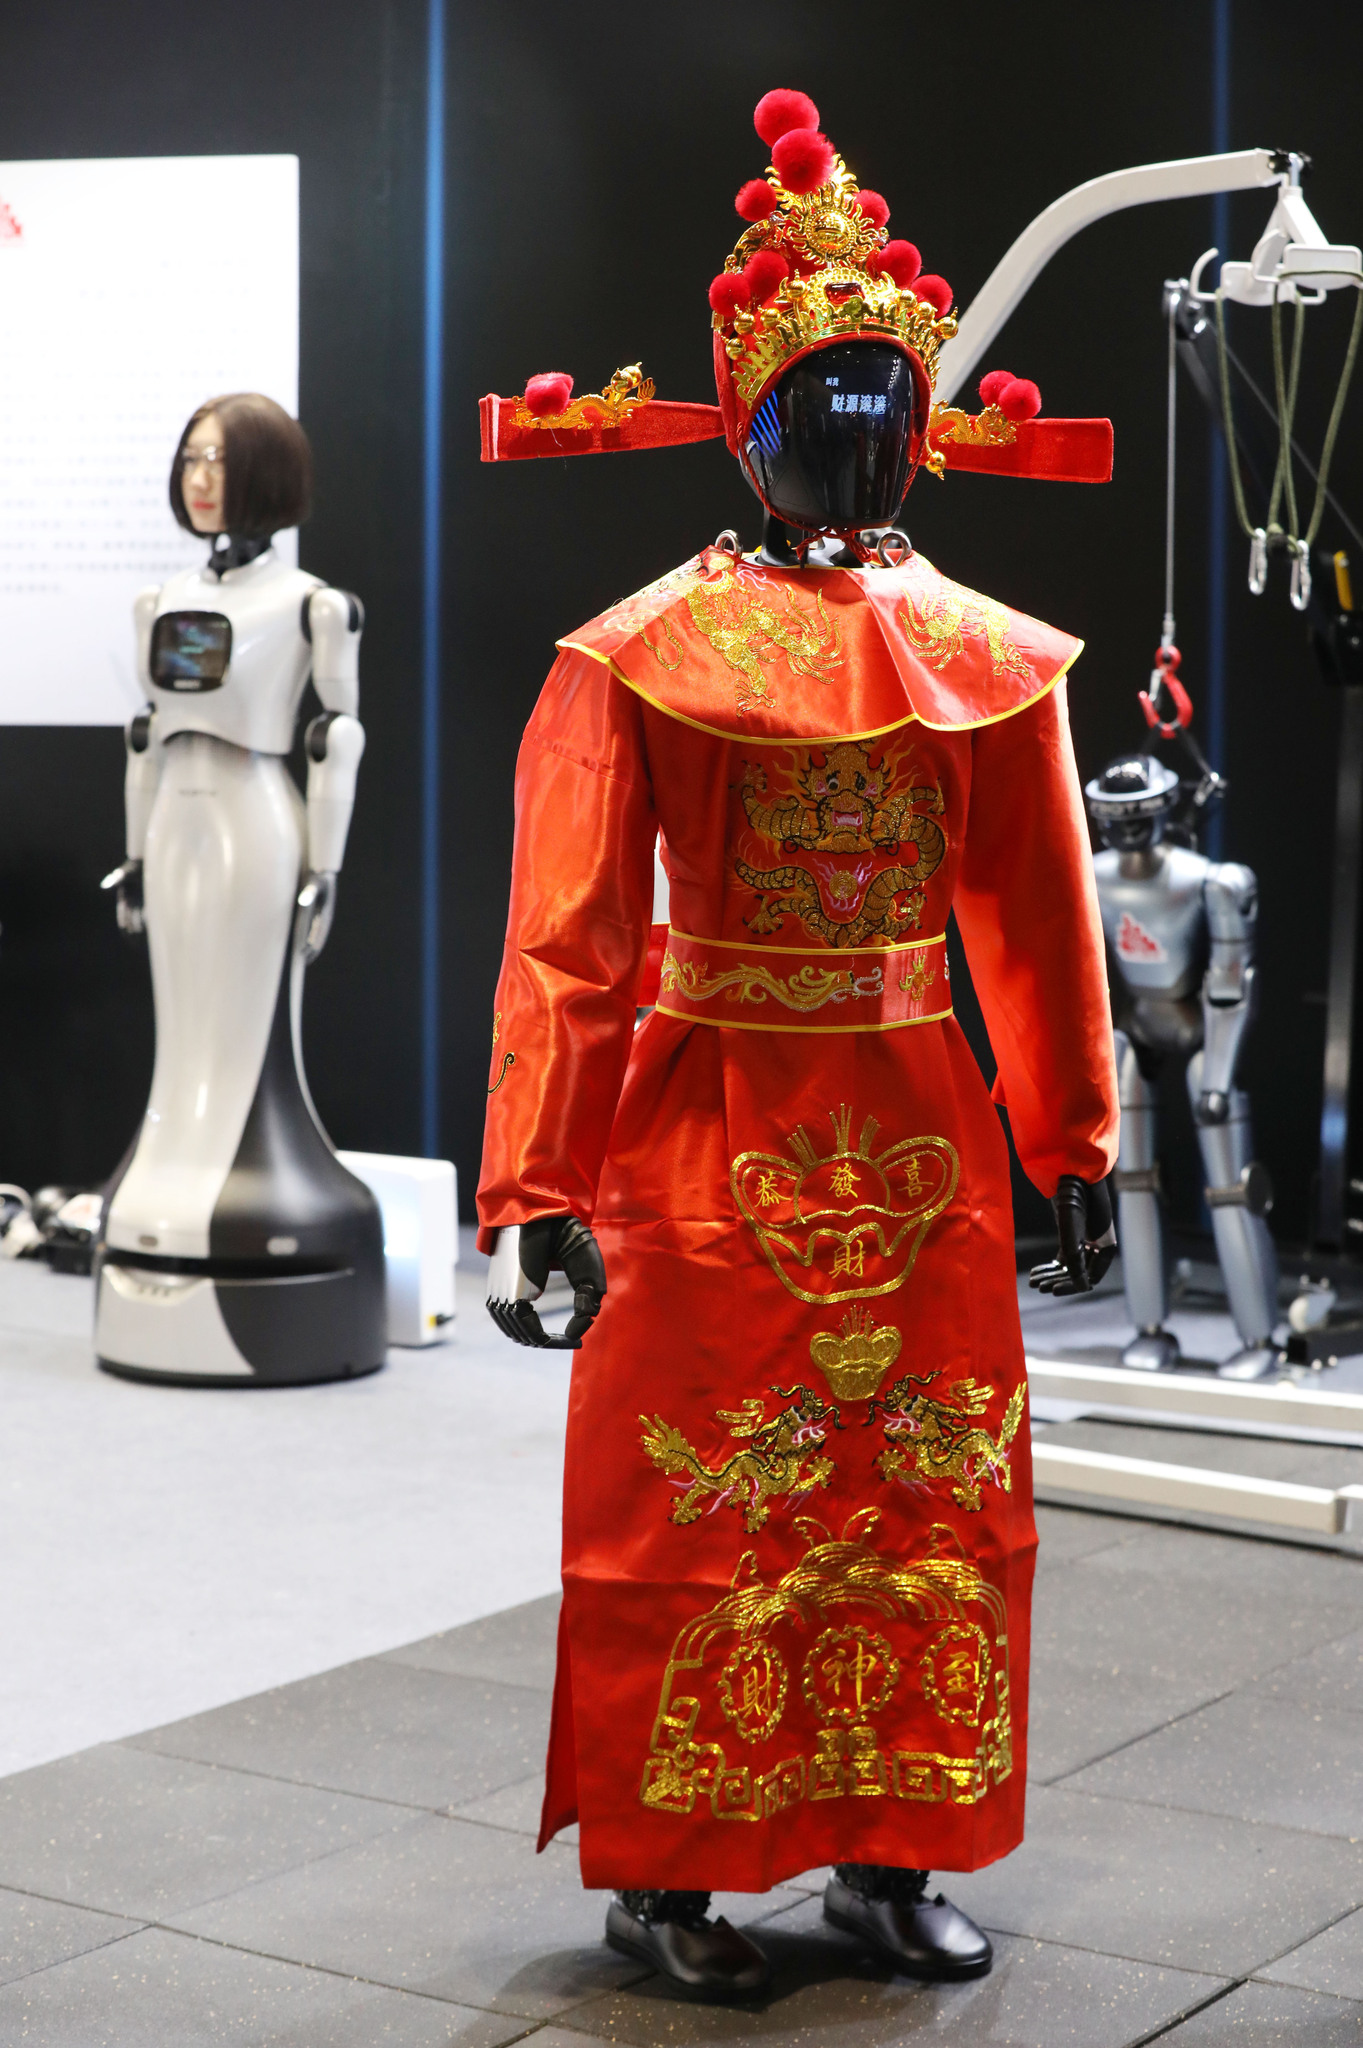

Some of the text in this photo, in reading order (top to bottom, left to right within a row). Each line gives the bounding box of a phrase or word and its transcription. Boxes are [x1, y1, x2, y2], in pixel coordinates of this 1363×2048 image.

[754, 1170, 791, 1208] 恭
[828, 1162, 862, 1199] 發
[897, 1158, 935, 1199] 喜
[829, 1239, 867, 1280] 財
[821, 1641, 878, 1706] 神
